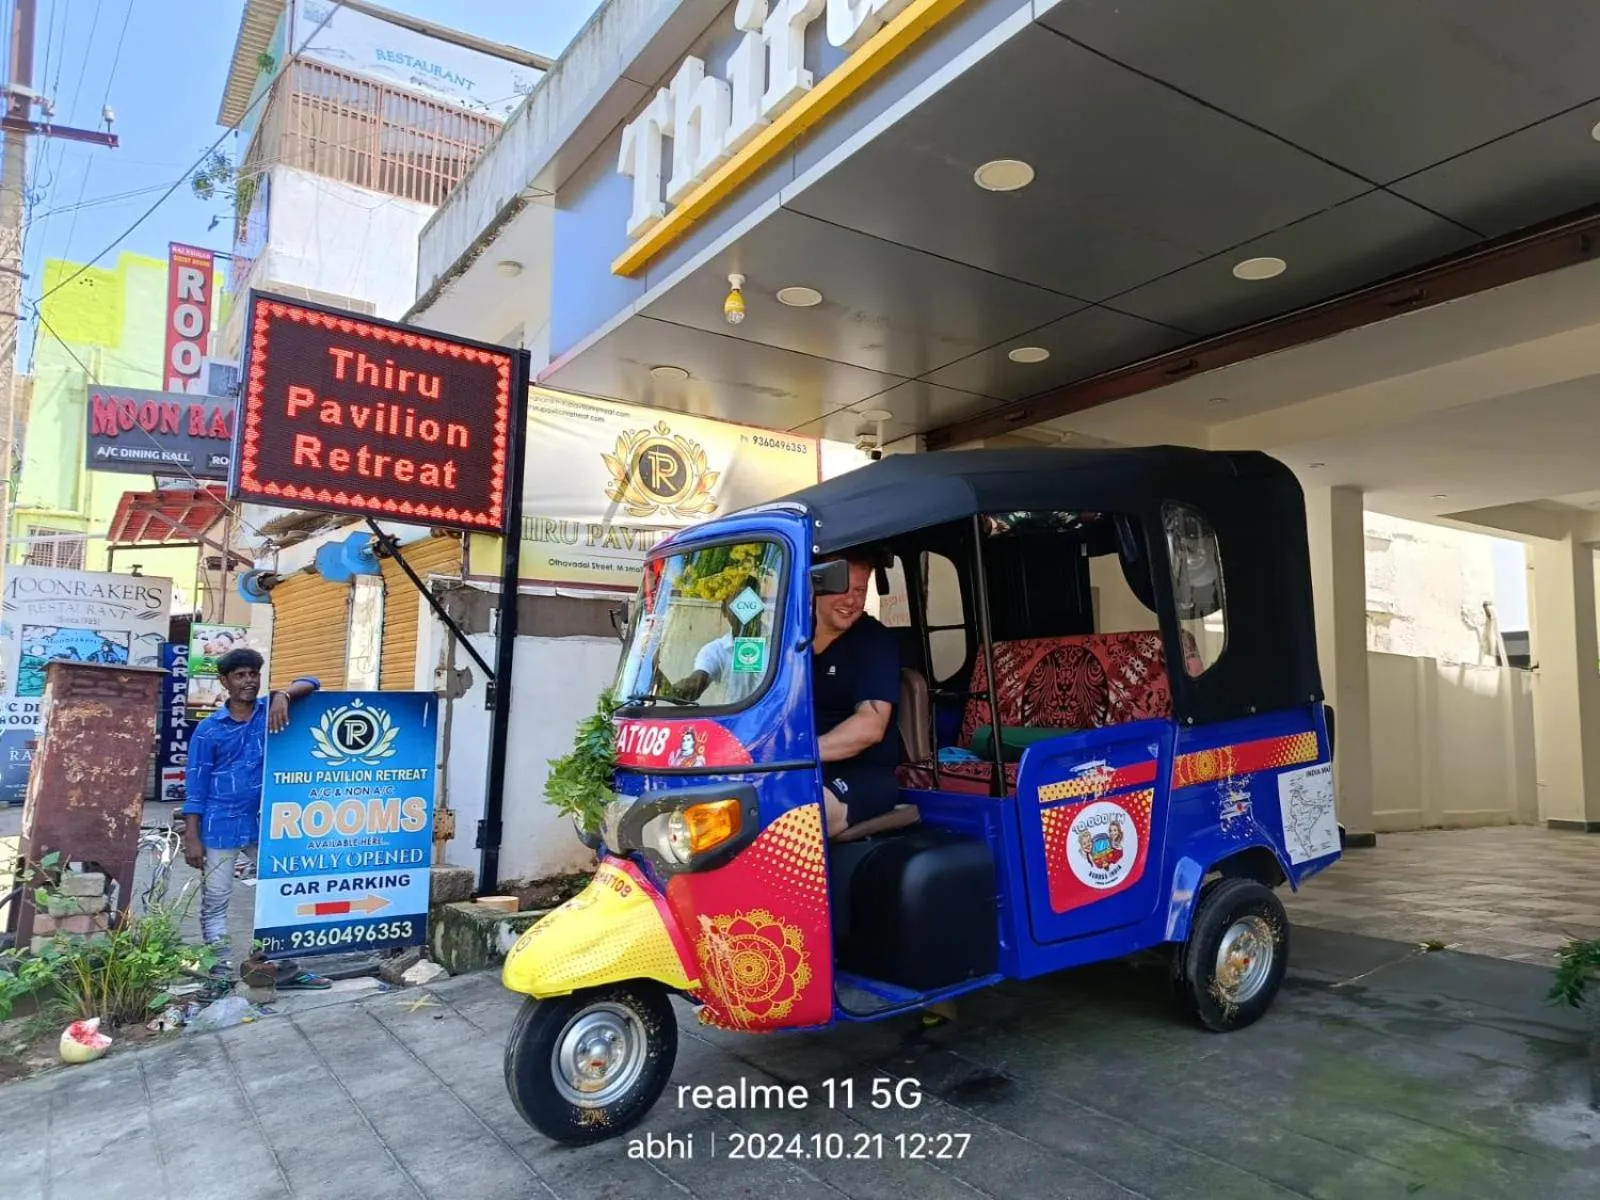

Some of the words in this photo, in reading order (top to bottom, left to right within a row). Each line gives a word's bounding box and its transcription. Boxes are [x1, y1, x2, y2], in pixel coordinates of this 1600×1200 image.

[376, 49, 475, 91] RESTAURANT
[329, 347, 441, 399] Thiru
[91, 393, 180, 438] MOON
[188, 402, 237, 440] RA
[287, 384, 469, 448] Pavilion
[97, 446, 118, 457] A/C
[120, 448, 160, 460] DINING
[162, 452, 190, 462] HALL
[752, 435, 808, 454] 9360496353
[212, 456, 229, 465] RO
[294, 433, 457, 489] Retreat
[521, 516, 580, 545] HIRU
[28, 601, 128, 620] RESTAURANT
[736, 601, 757, 610] CNG
[171, 644, 188, 678] CAR
[170, 682, 188, 766] PARKING
[614, 724, 671, 756] AT108
[273, 772, 312, 784] THIRU
[316, 770, 372, 783] PAVILION
[376, 768, 428, 781] RETREAT
[1306, 768, 1321, 777] INDIA
[334, 788, 342, 797] &
[345, 786, 370, 796] NON
[270, 796, 428, 840] ROOMS
[308, 839, 358, 849] AVAILABLE
[271, 852, 343, 874] NEWLY
[346, 848, 423, 867] OPENED
[280, 881, 320, 897] CAR
[327, 874, 411, 893] PARKING
[262, 936, 285, 951] Ph:
[291, 920, 412, 949] 9360496353
